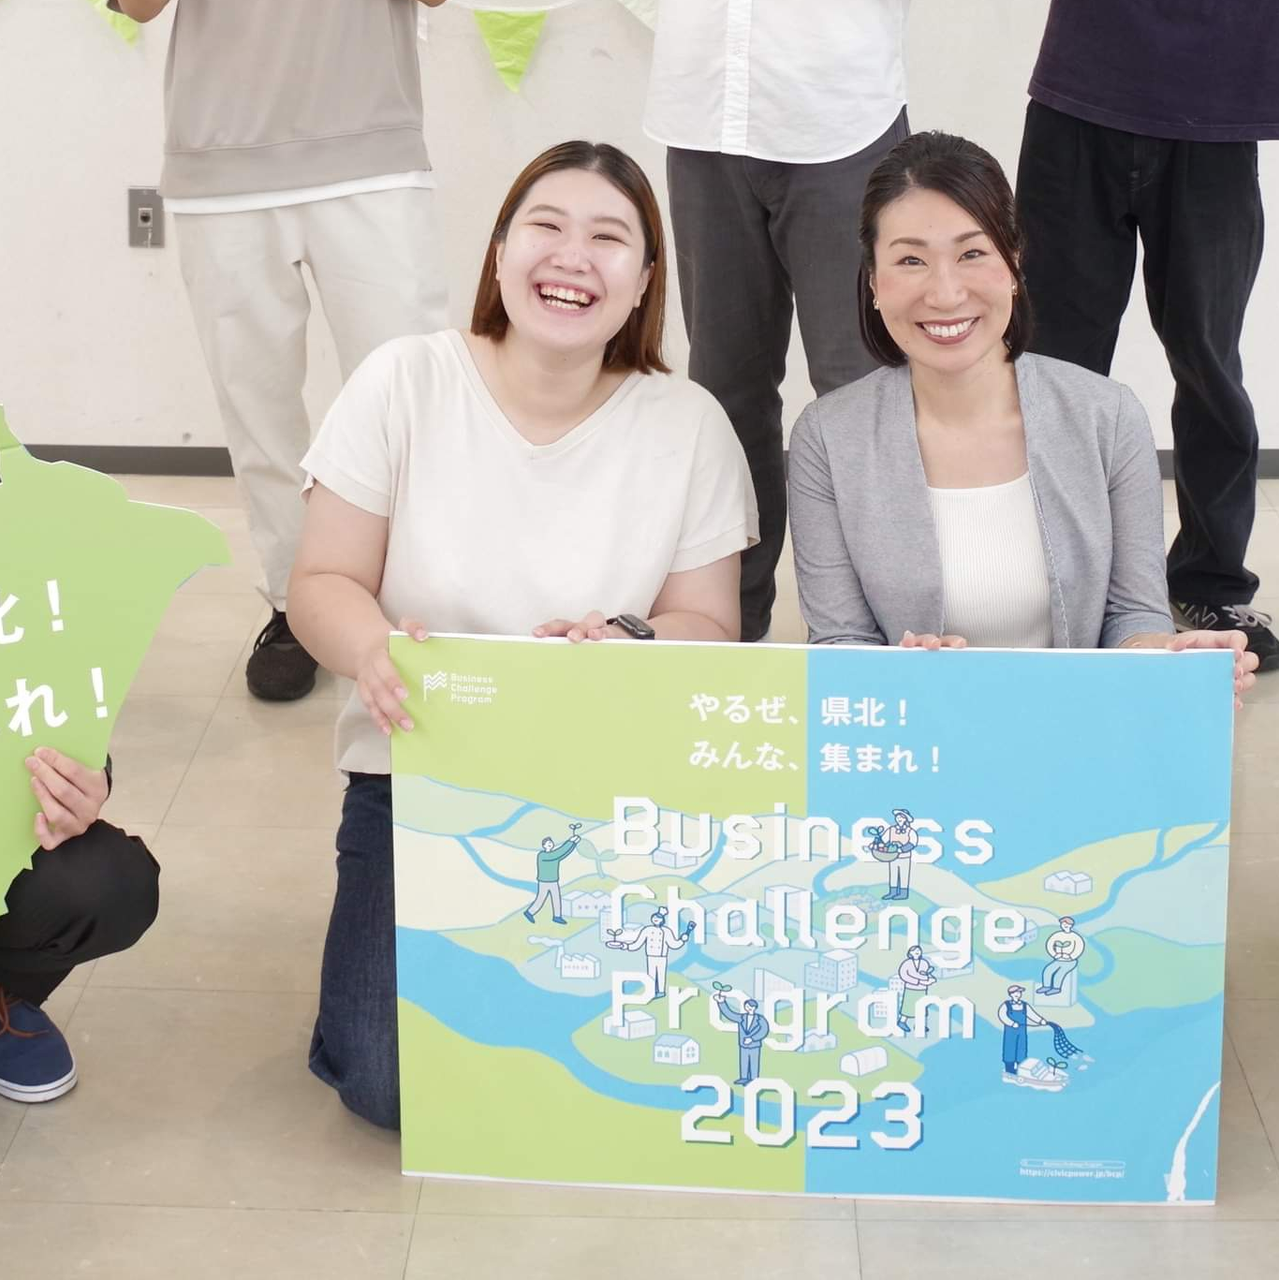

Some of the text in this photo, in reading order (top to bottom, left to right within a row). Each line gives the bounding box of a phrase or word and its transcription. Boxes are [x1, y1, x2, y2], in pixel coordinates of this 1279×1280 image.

[613, 795, 995, 866] Business
[609, 883, 1028, 970] Challenge
[611, 970, 976, 1053] Program
[680, 1074, 925, 1151] 2023
